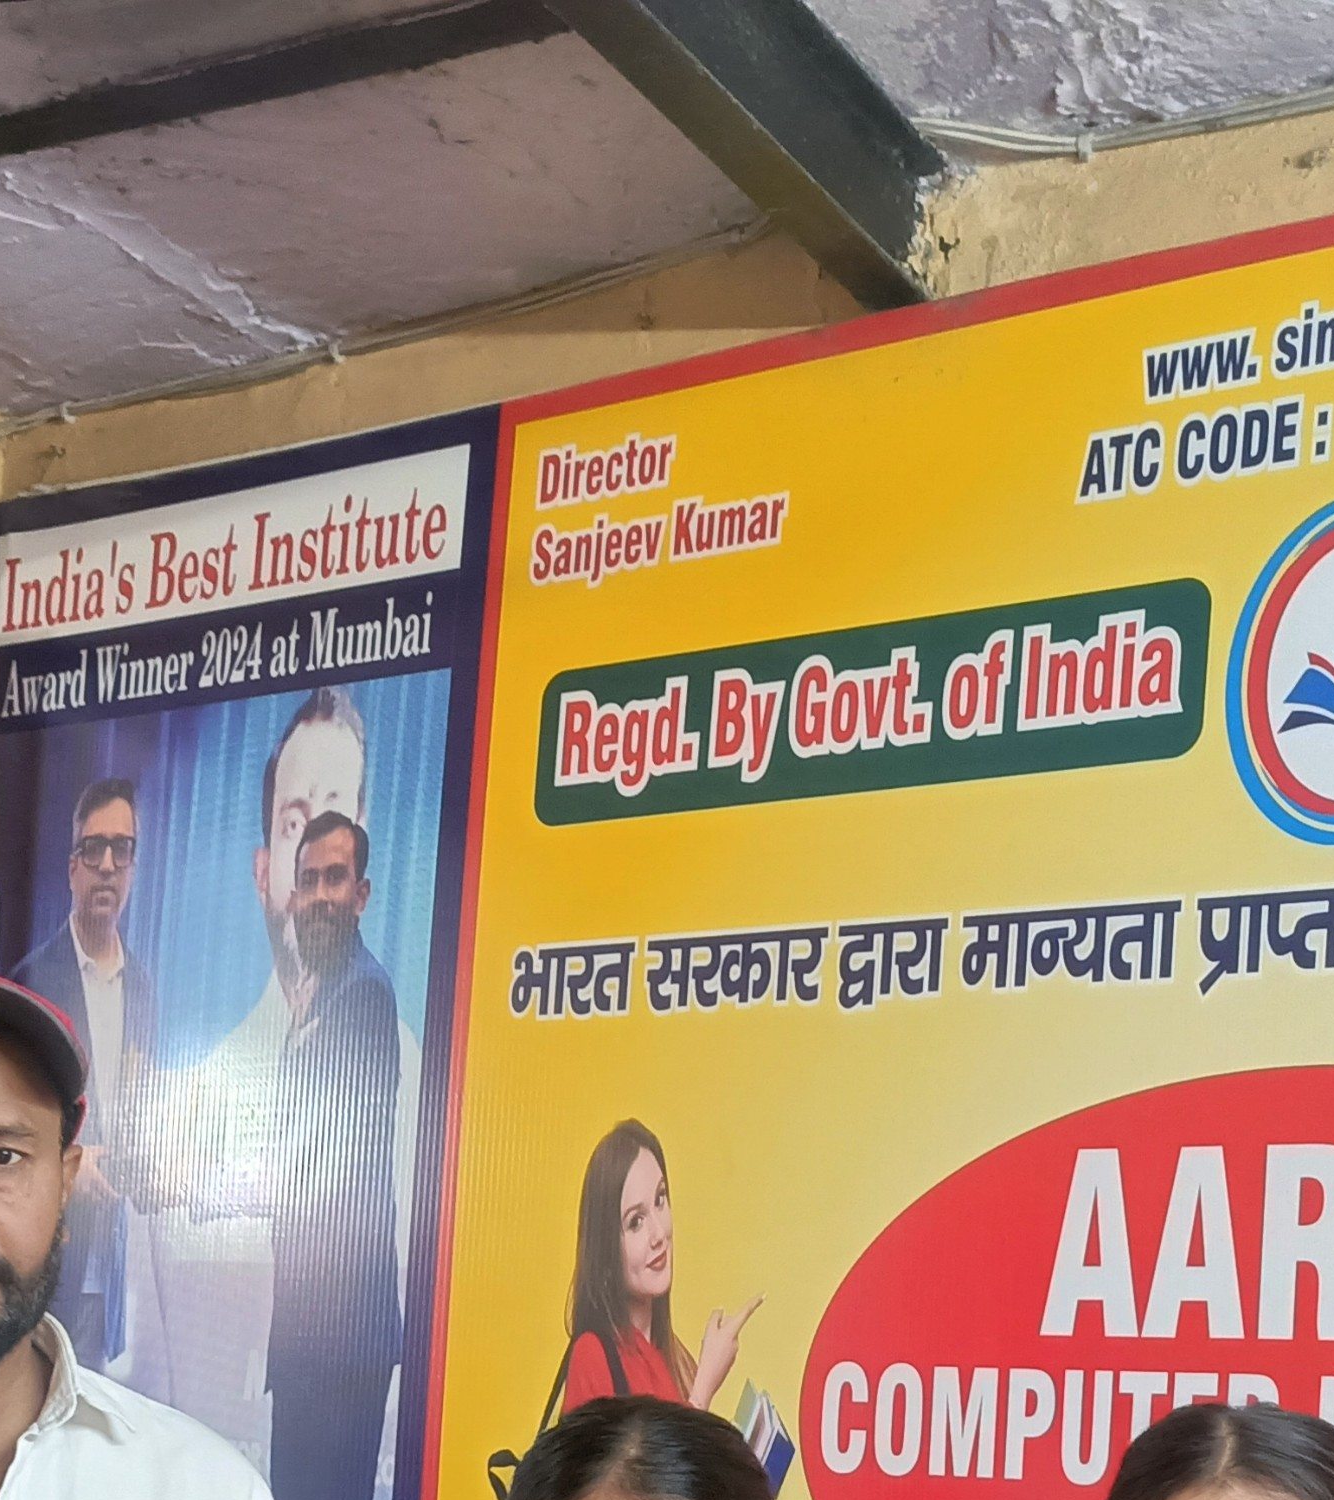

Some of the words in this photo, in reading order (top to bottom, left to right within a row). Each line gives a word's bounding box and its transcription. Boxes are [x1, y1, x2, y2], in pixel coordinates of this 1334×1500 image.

[1146, 335, 1257, 399] www.
[539, 438, 672, 504] Director
[1080, 430, 1158, 496] ATC
[1178, 408, 1296, 478] CODE
[2, 541, 135, 633] India's
[145, 525, 237, 610] Best
[248, 487, 446, 592] Institute
[533, 515, 661, 584] Sanjeev
[673, 496, 785, 555] Kumar
[1, 649, 87, 718] Award
[96, 643, 194, 705] Winner
[201, 621, 262, 689] 2024
[271, 626, 299, 676] at
[306, 592, 433, 672] Mumbai
[560, 680, 697, 790] Regd.
[714, 672, 775, 774] By
[794, 655, 927, 750] Govt.
[948, 647, 1008, 732] of
[1030, 615, 1178, 720] India
[510, 942, 634, 1016] भारत
[647, 928, 824, 1010] सरकार
[838, 918, 946, 1008] द्वारा
[964, 903, 1180, 987] मान्यता
[820, 1361, 1273, 1483] COMPUT
